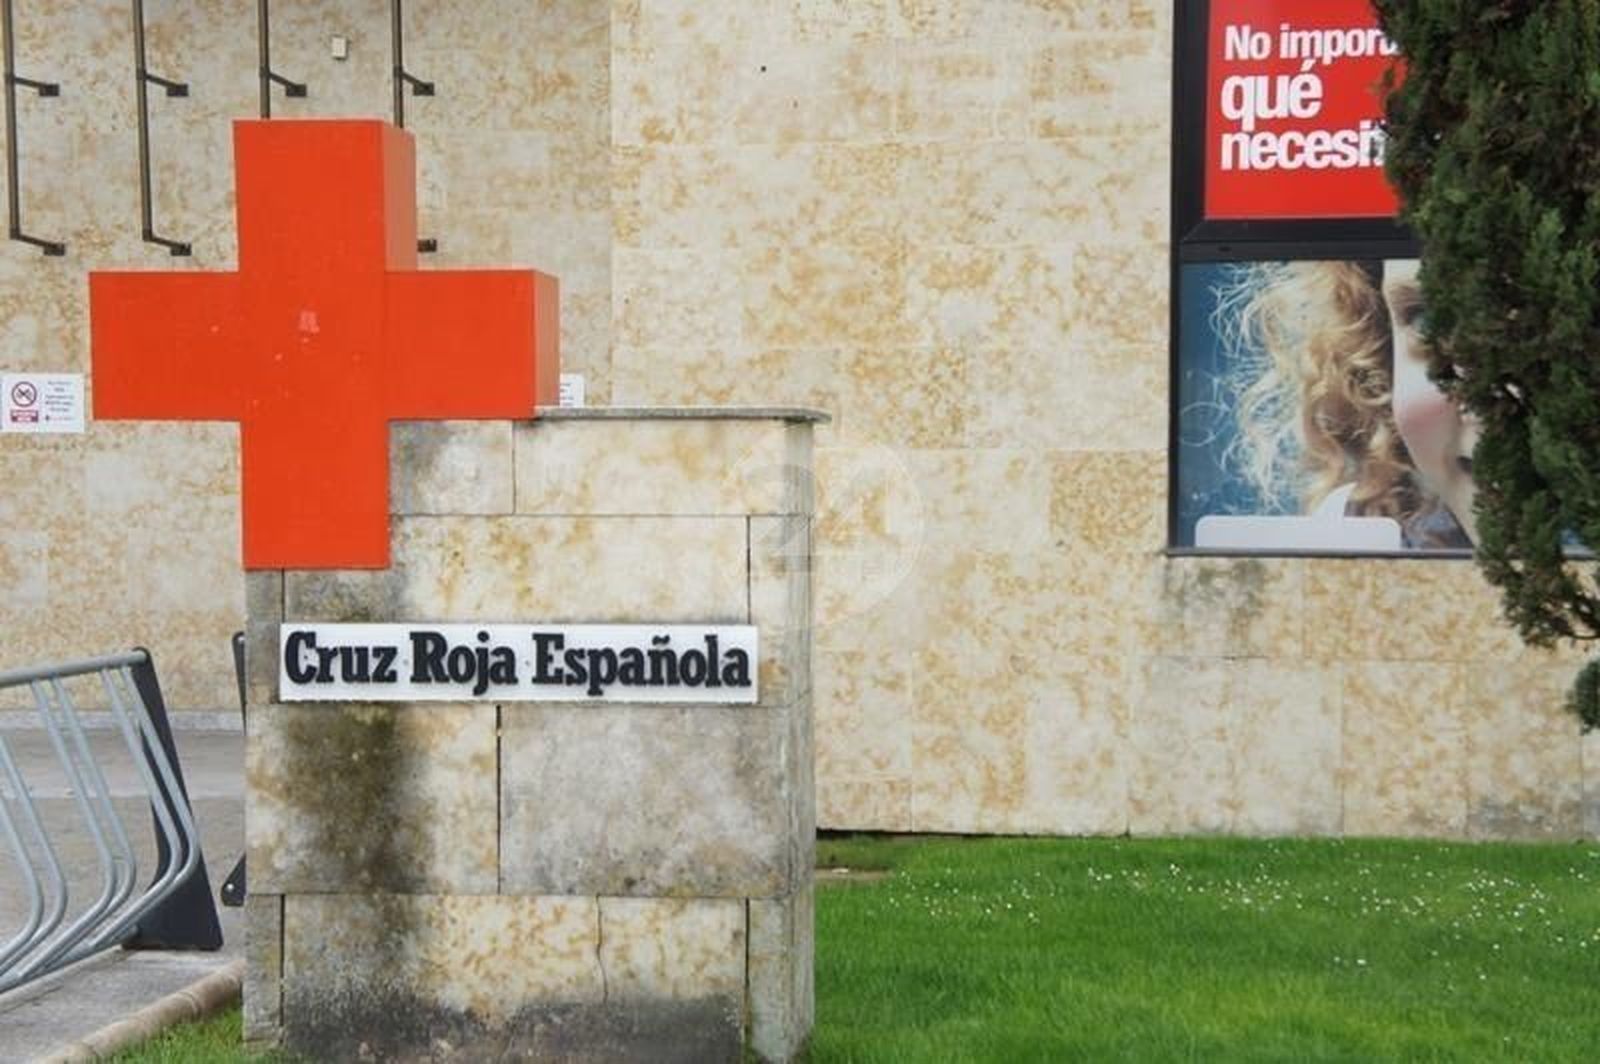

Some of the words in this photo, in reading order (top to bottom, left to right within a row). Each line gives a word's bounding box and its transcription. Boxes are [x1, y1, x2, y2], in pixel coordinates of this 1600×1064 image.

[1224, 25, 1271, 60] No
[1220, 59, 1323, 132] qué
[284, 630, 398, 685] Cruz
[409, 630, 518, 696] Roja
[531, 633, 752, 696] Española
